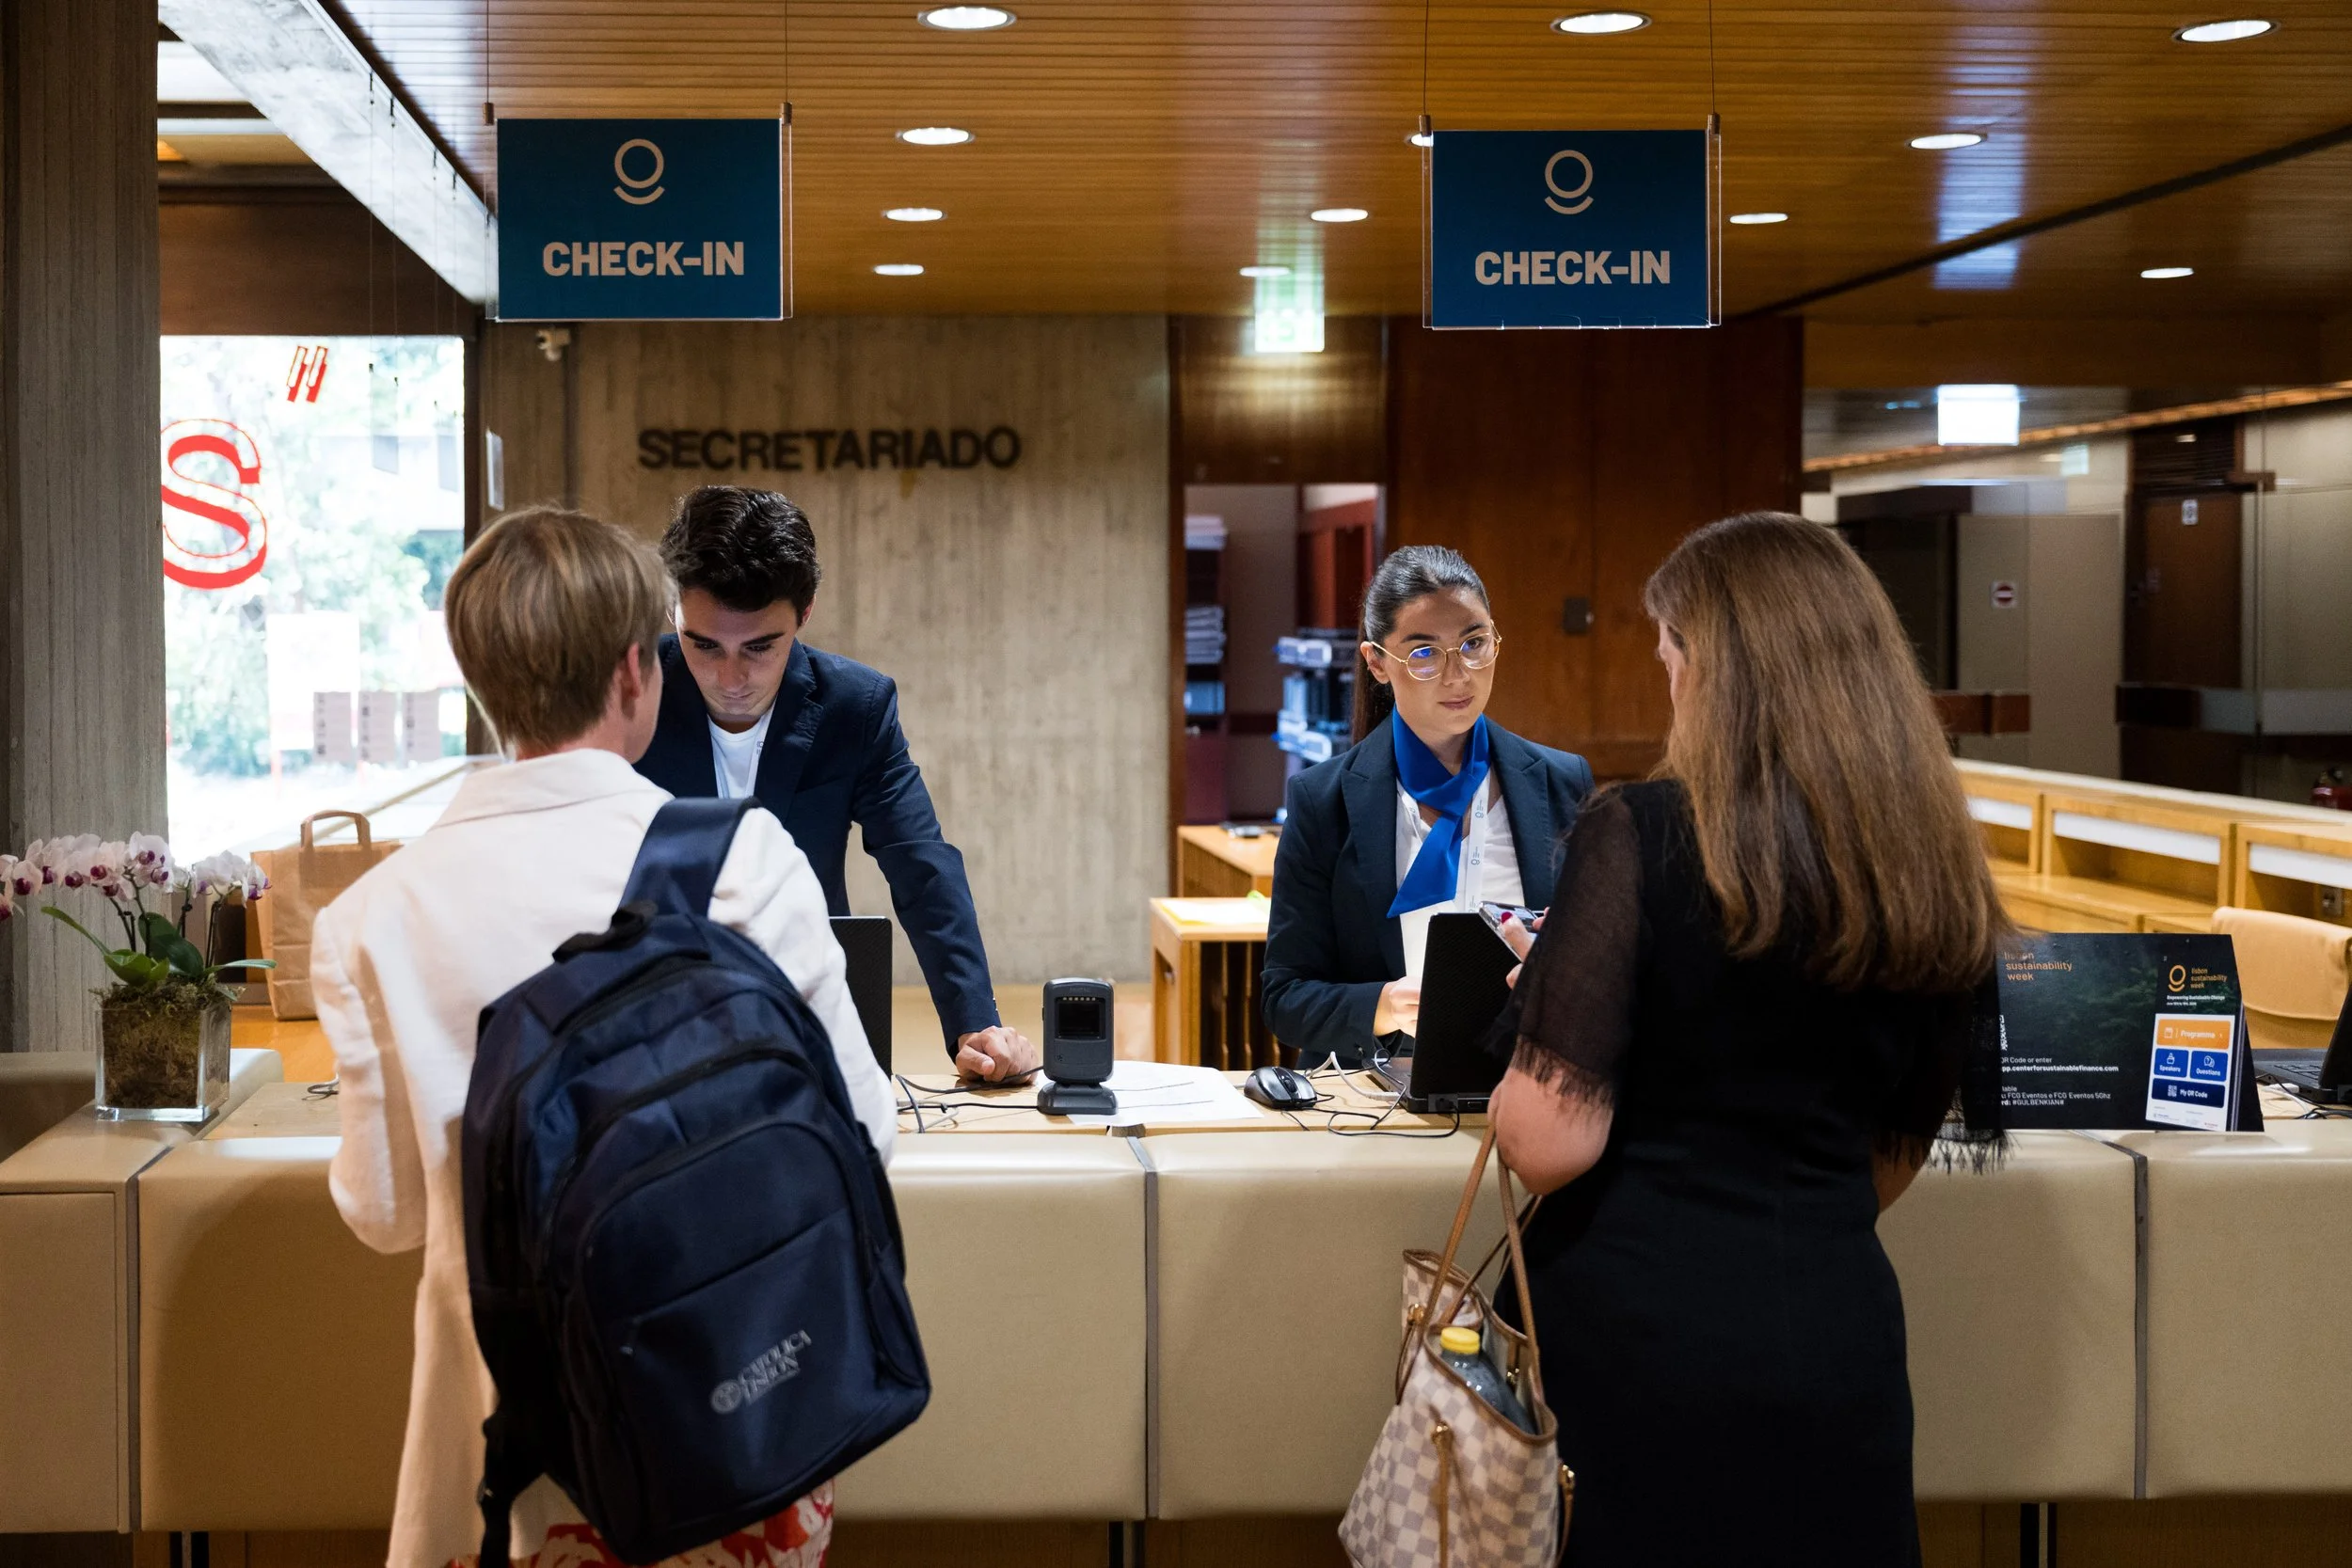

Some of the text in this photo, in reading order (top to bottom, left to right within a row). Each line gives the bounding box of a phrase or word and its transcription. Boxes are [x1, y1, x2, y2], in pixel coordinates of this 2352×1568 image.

[543, 241, 744, 277] CHECK-IN
[1475, 250, 1670, 285] CHECK-IN
[637, 426, 1022, 471] SECRETARIADO
[2005, 961, 2073, 972] sustainability
[2007, 973, 2034, 981] week
[2181, 1030, 2217, 1039] Programme
[2196, 1068, 2221, 1077] Questions
[2195, 1090, 2208, 1099] Code
